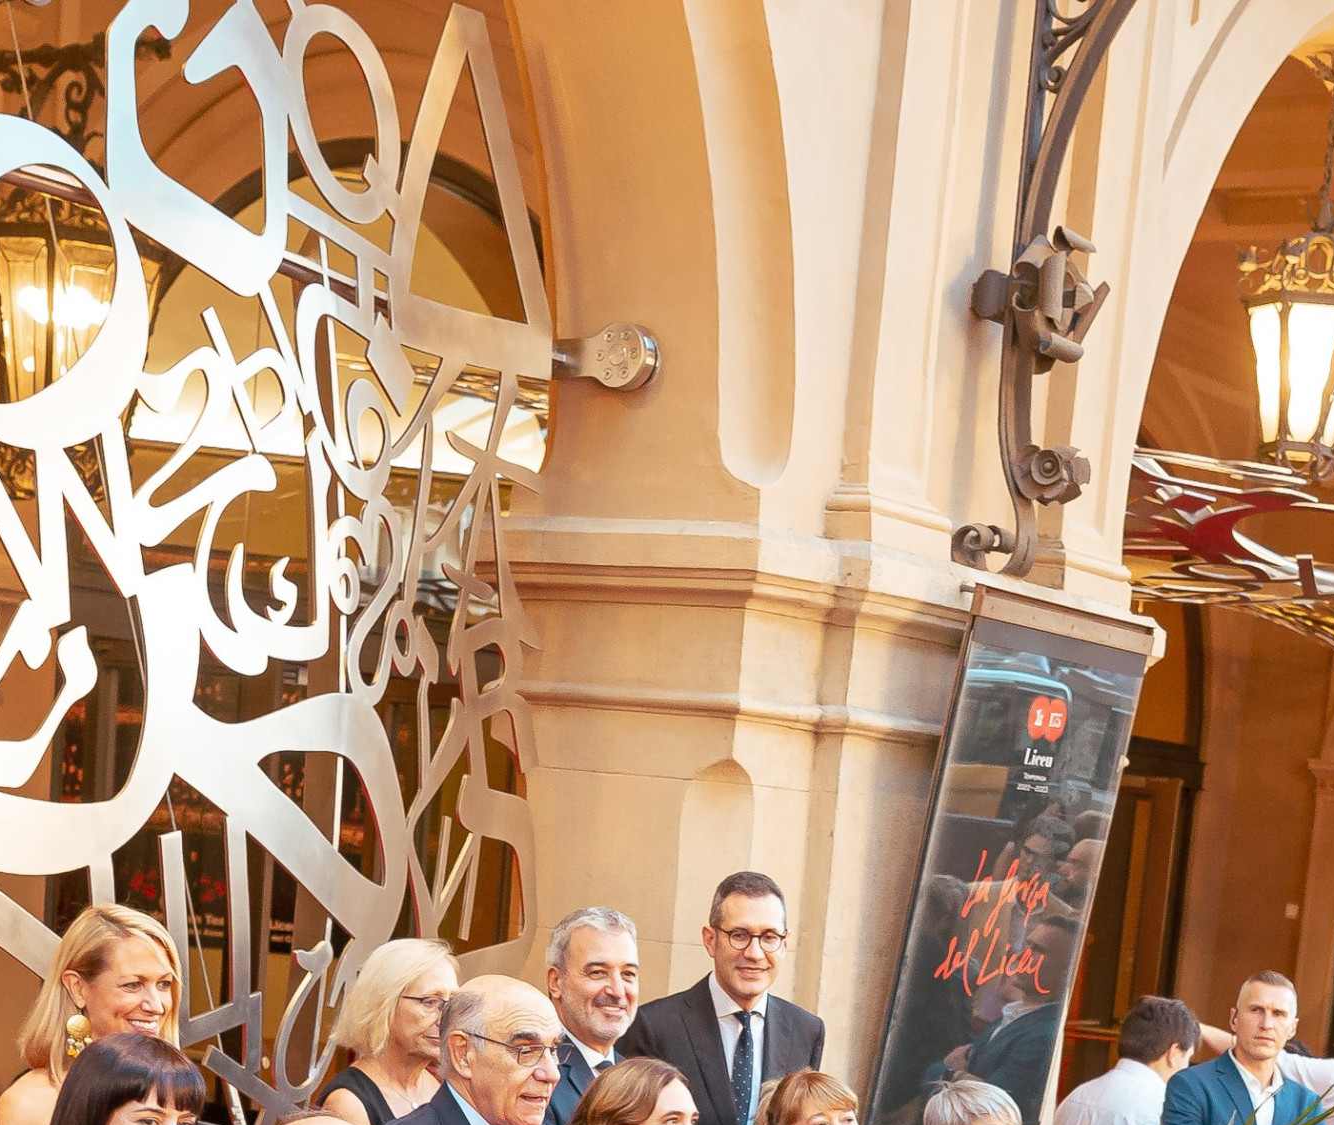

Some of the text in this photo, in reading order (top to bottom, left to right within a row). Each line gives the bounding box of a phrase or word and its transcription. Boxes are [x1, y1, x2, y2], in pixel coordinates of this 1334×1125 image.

[1023, 748, 1054, 768] Liceu
[933, 928, 1051, 997] del Liceu
